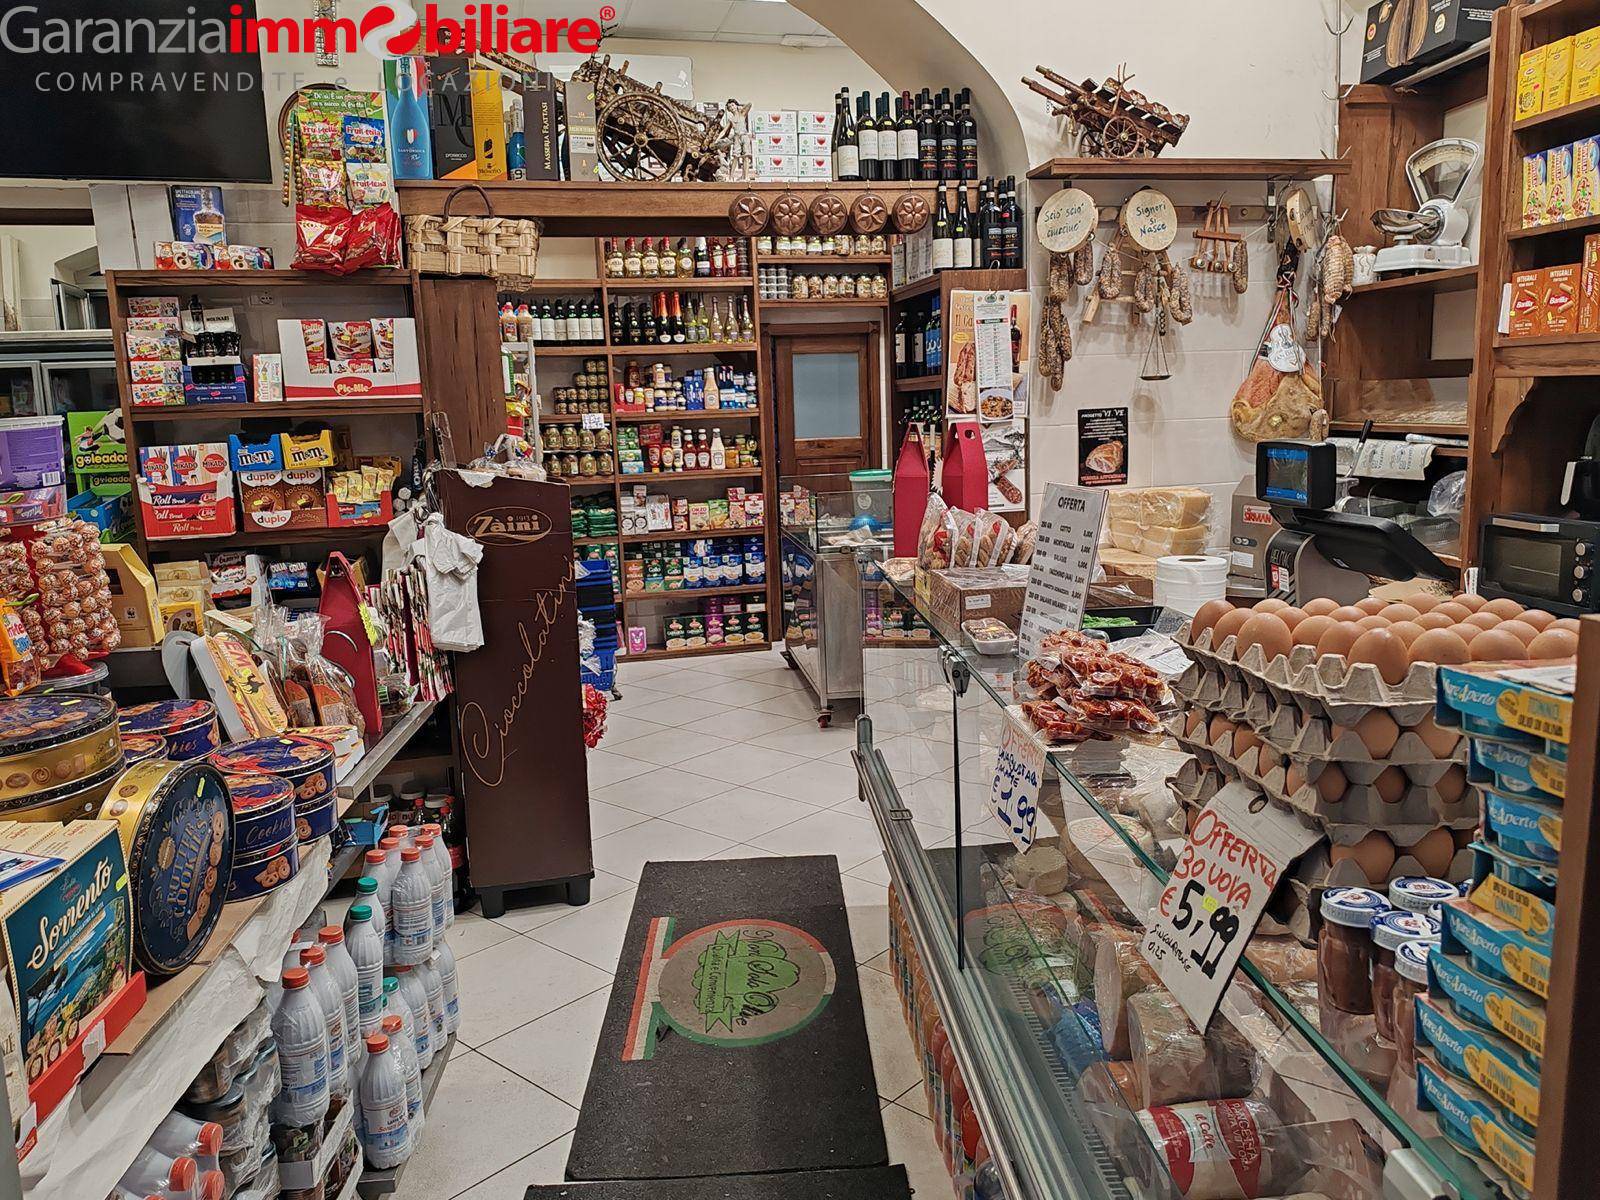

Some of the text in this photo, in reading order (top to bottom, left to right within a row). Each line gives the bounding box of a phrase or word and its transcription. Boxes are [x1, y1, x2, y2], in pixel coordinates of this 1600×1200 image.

[246, 473, 276, 483] duplo
[286, 470, 316, 481] duplo
[153, 494, 172, 505] Roll
[1057, 496, 1086, 513] OFFERTA
[257, 514, 287, 525] duplo
[172, 523, 190, 532] Roll
[1189, 809, 1278, 890] OFFERTA
[1174, 845, 1251, 910] 30 UOVA
[1159, 886, 1178, 917] €
[26, 856, 114, 971] Sorrento
